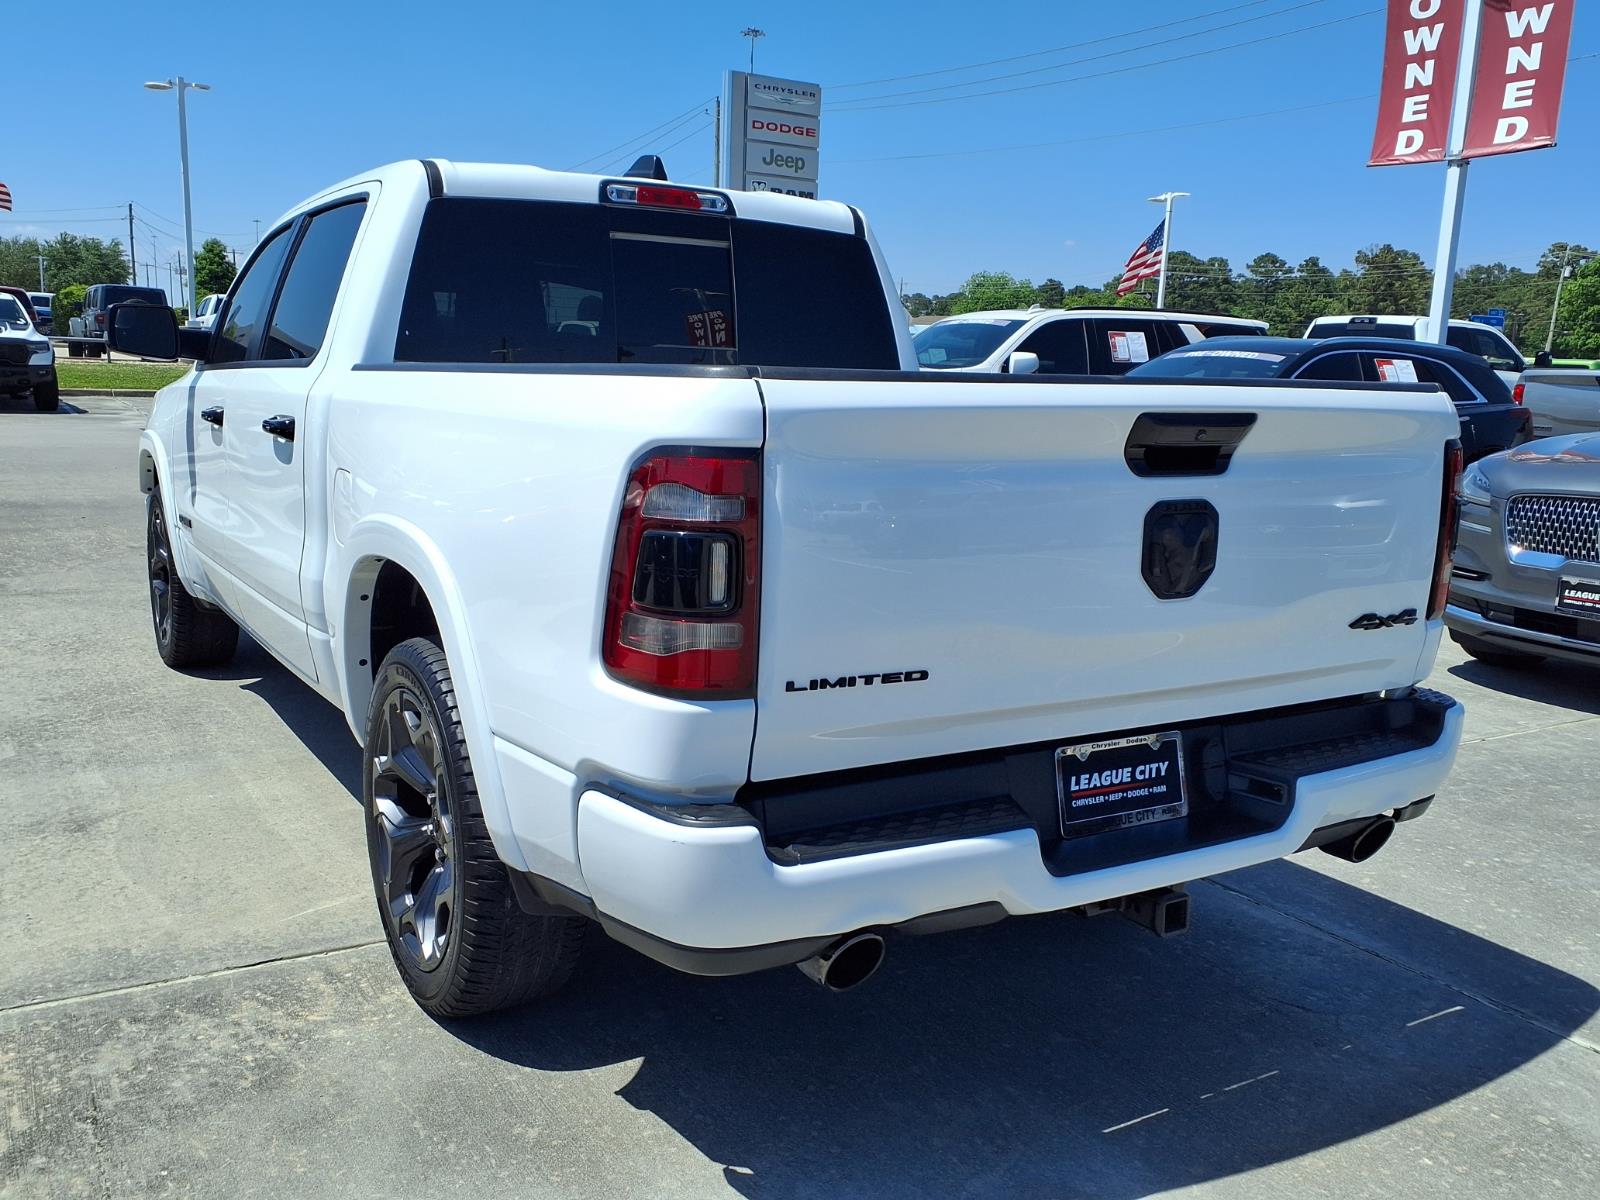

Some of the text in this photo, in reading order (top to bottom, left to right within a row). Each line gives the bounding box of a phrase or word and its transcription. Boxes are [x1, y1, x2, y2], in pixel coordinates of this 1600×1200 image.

[1394, 0, 1445, 156] OWNED
[754, 83, 816, 98] CHRYSLER
[752, 120, 817, 138] DODGE
[762, 148, 806, 173] Jeep
[1564, 589, 1600, 601] LEAGUE
[785, 669, 930, 693] LIMITED
[1091, 740, 1120, 750] Chrysler
[1070, 767, 1132, 791] LEAGUE
[1135, 761, 1169, 780] CITY
[1071, 784, 1167, 808] CHRYSLER JEEP DODGE RAM
[1136, 808, 1157, 822] CITY
